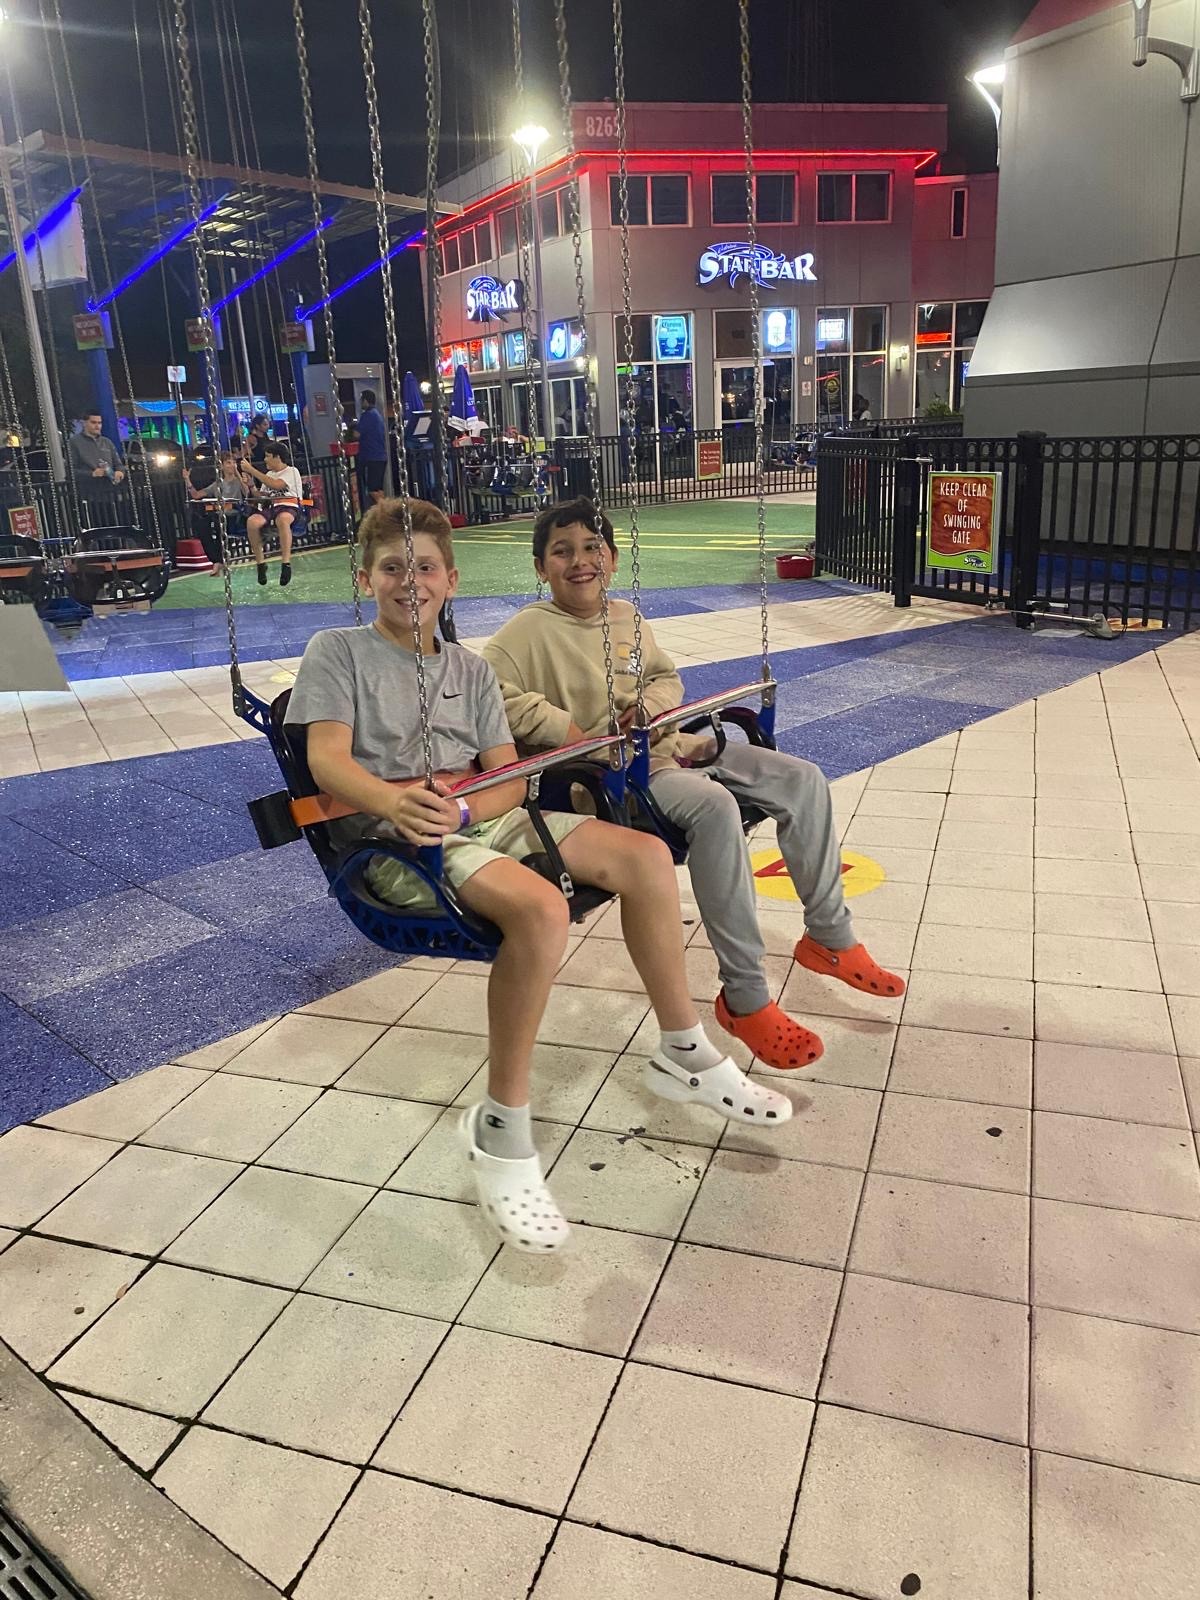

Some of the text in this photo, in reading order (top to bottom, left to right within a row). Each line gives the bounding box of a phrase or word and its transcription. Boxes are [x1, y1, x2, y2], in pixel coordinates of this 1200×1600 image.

[760, 252, 818, 281] BAR
[491, 279, 519, 310] BAR
[940, 482, 987, 497] KEEP CLEAR
[957, 499, 968, 512] OF
[943, 514, 981, 529] SWINGING
[952, 530, 971, 544] GATE
